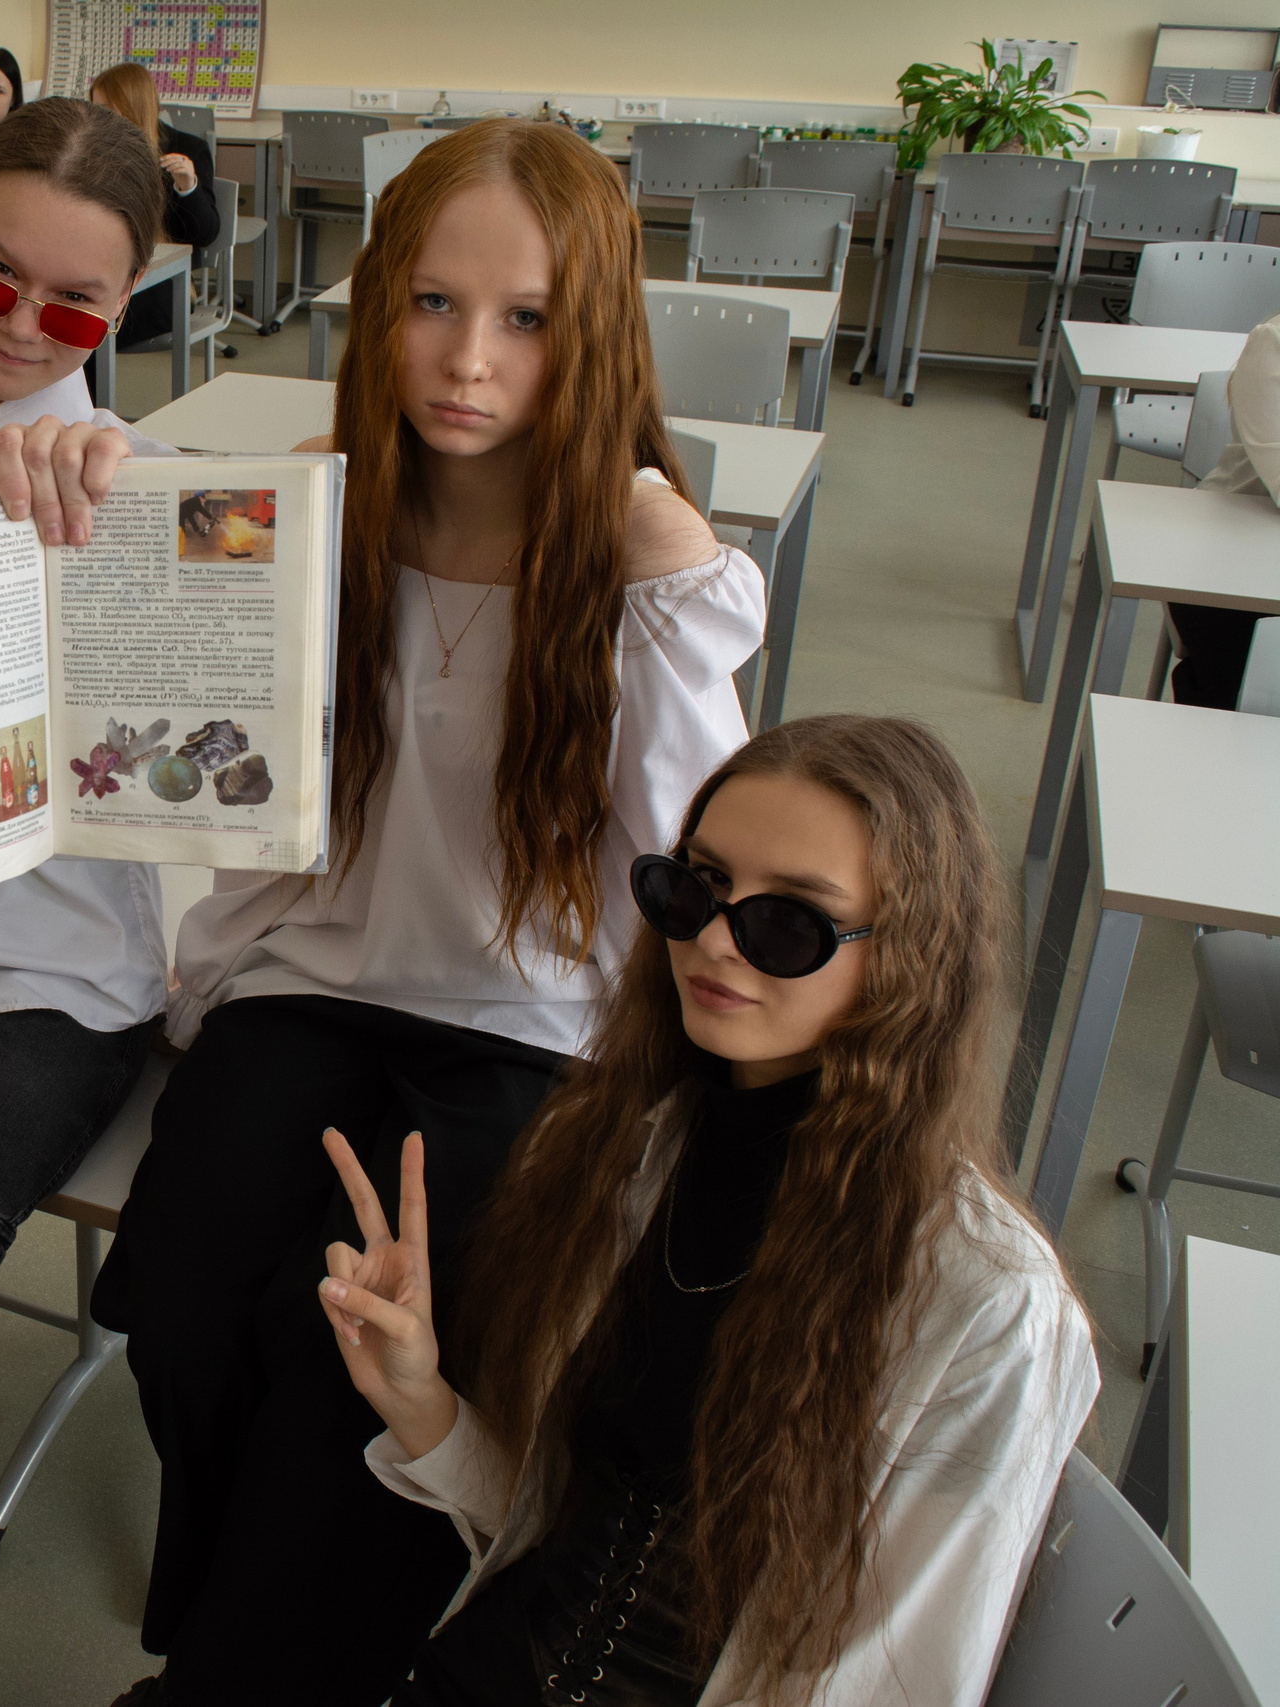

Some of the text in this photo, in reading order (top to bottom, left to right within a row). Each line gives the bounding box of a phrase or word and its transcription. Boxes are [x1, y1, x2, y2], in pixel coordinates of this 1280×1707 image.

[127, 556, 151, 564] сухой
[60, 564, 94, 572] который
[205, 568, 237, 577] Тушение
[237, 569, 264, 577] пожара
[86, 580, 115, 588] причём
[61, 595, 93, 604] Поэтому
[93, 596, 117, 604] сухой
[117, 596, 131, 604] лёд
[227, 606, 275, 614] мороженого
[188, 614, 234, 622] используют
[236, 614, 252, 622] при
[98, 621, 153, 629] газированных
[245, 631, 274, 639] потому
[200, 645, 223, 653] белое
